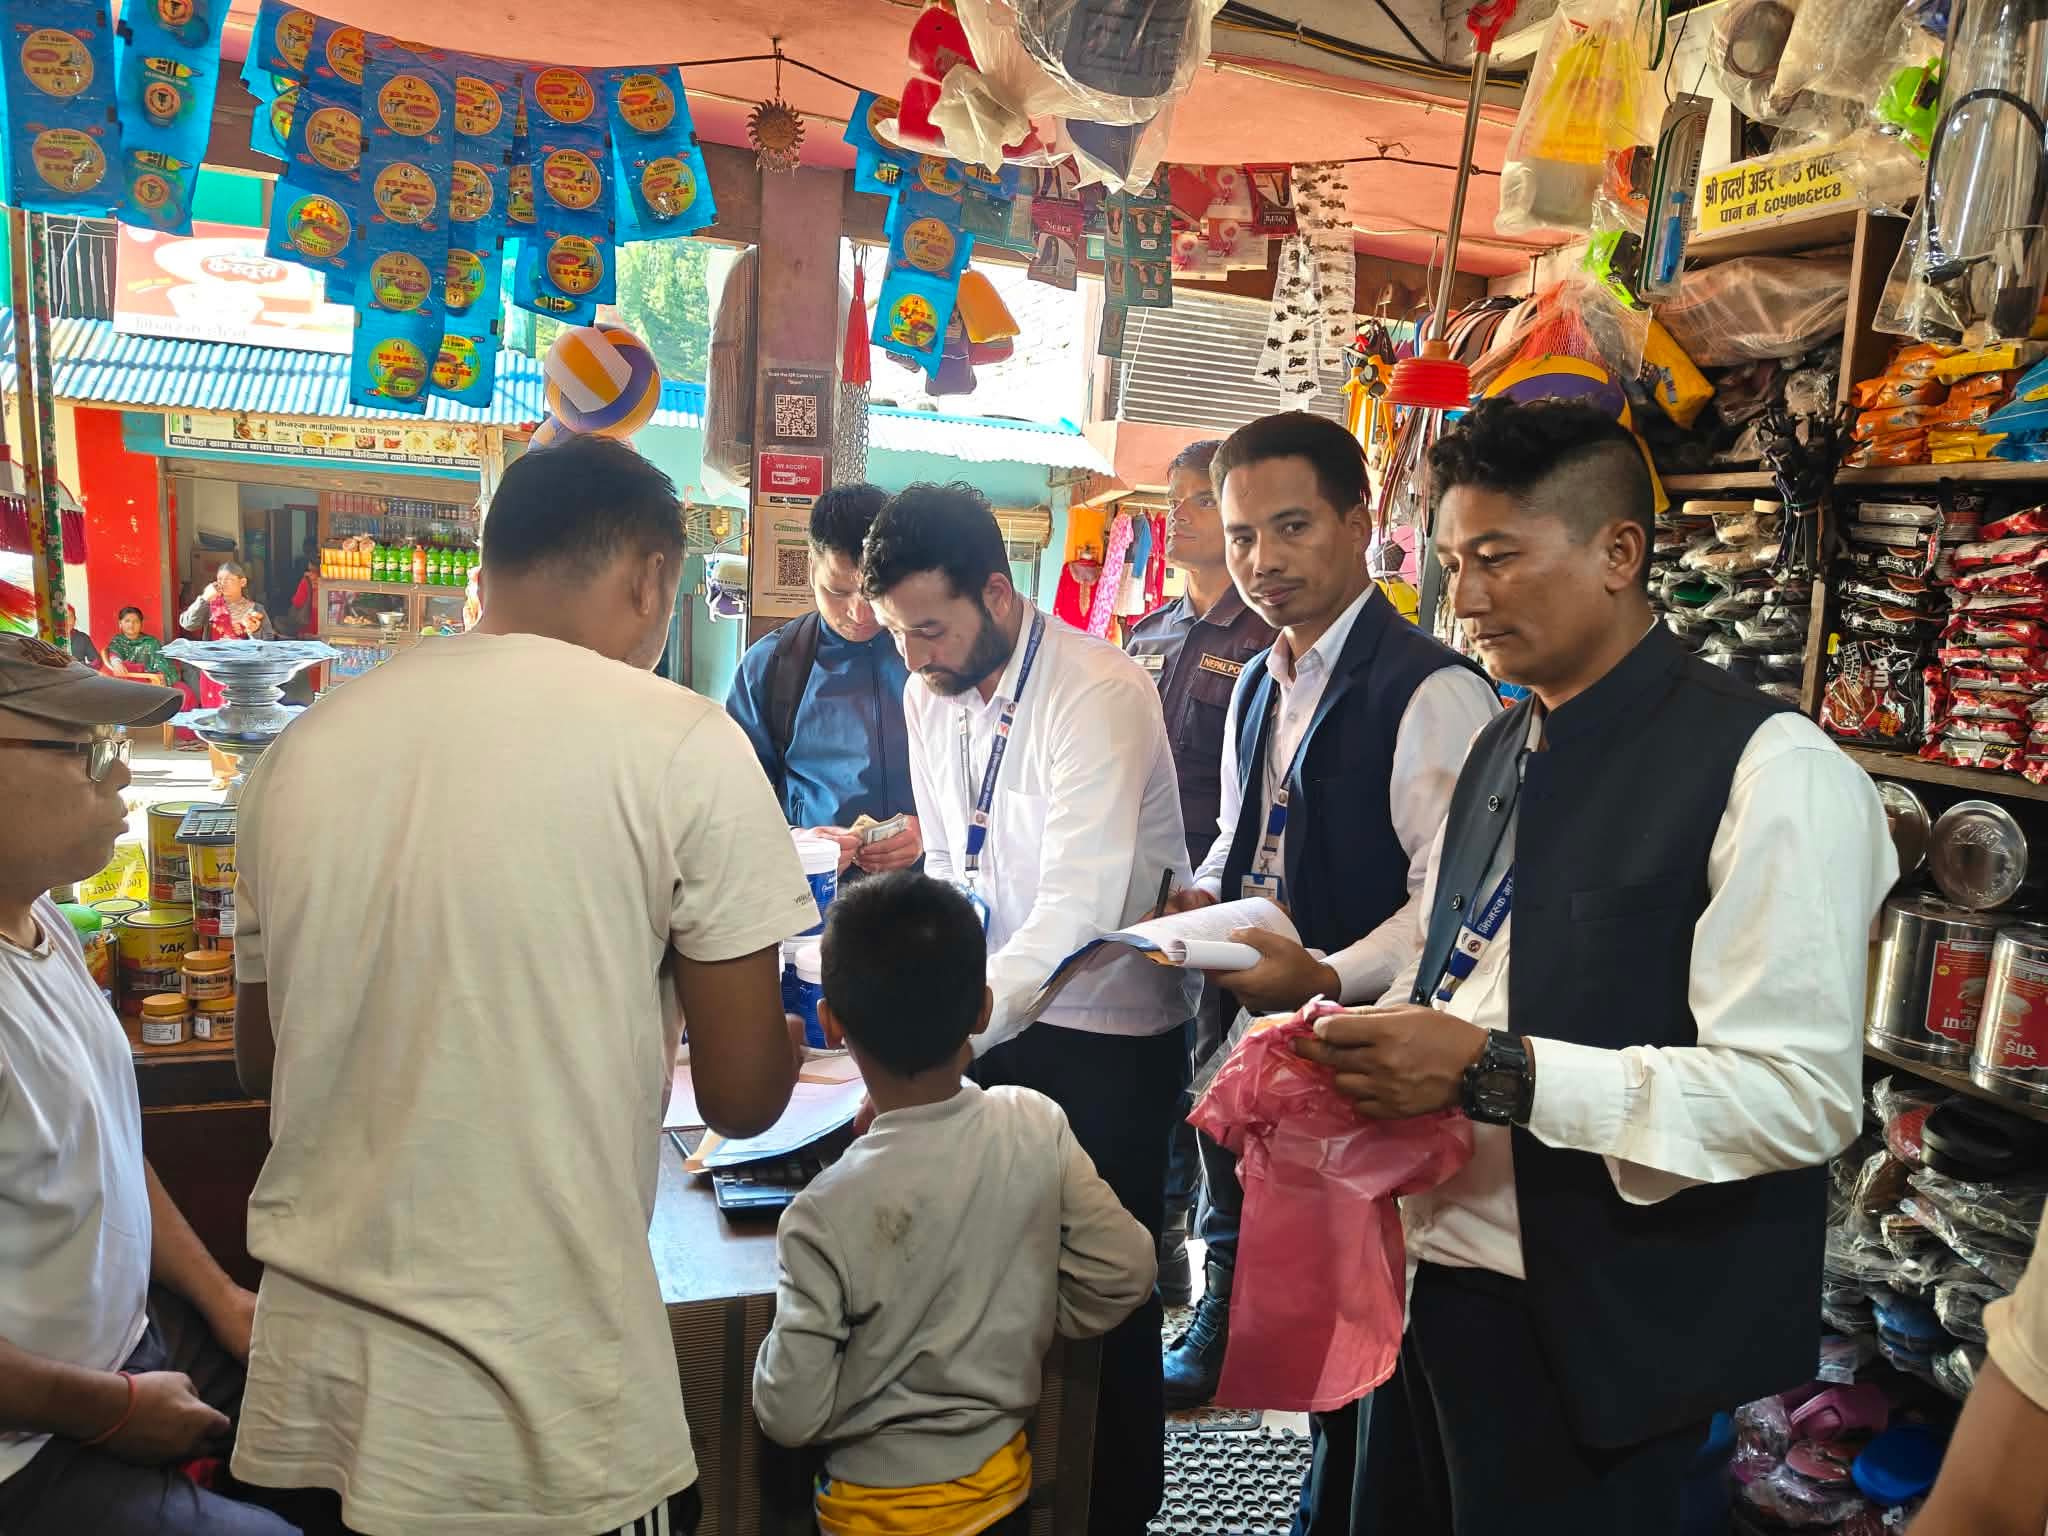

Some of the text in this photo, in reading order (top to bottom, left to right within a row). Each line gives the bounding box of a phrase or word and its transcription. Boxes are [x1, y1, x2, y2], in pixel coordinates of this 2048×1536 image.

[1203, 656, 1227, 672] NEPAL
[216, 862, 237, 873] YA
[159, 942, 185, 954] YAK
